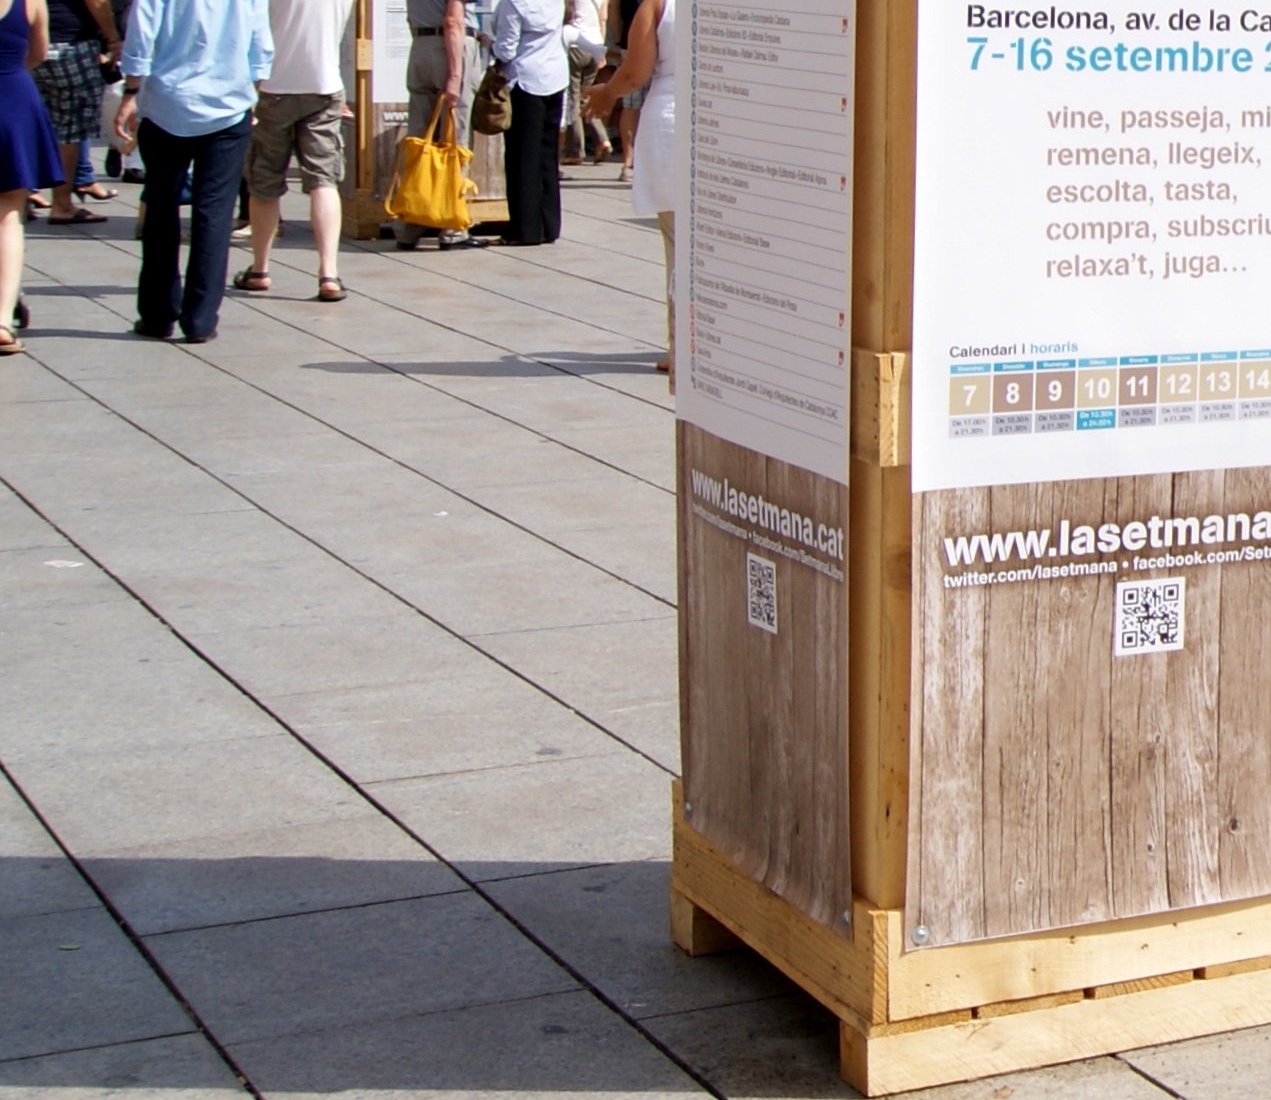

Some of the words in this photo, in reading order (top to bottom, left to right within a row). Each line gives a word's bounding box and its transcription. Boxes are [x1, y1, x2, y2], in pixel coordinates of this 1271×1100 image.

[967, 5, 1116, 35] Barcelona,
[1125, 12, 1160, 32] av.
[1169, 8, 1201, 32] de
[1209, 9, 1232, 32] la
[967, 38, 1053, 72] 7-16
[1065, 40, 1253, 73] setembre
[1046, 106, 1111, 133] vine,
[1120, 107, 1232, 134] passeja,
[1046, 145, 1159, 169] remena,
[1168, 142, 1262, 170] llegeix,
[1046, 179, 1155, 207] escolta,
[1164, 181, 1238, 205] tasta,
[1046, 220, 1158, 244] compra,
[949, 343, 1018, 359] Calendari
[1030, 341, 1079, 355] horaris
[963, 384, 977, 407] 7
[1005, 382, 1020, 404] 8
[1047, 380, 1062, 402] 9
[1084, 377, 1111, 399] 10
[1125, 375, 1150, 398] 11
[1165, 373, 1192, 395] 12
[1205, 371, 1232, 392] 13
[1244, 368, 1271, 390] 14
[691, 467, 844, 562] www.lasetmana.cat
[943, 559, 1117, 588] twitter.com/lasetmana
